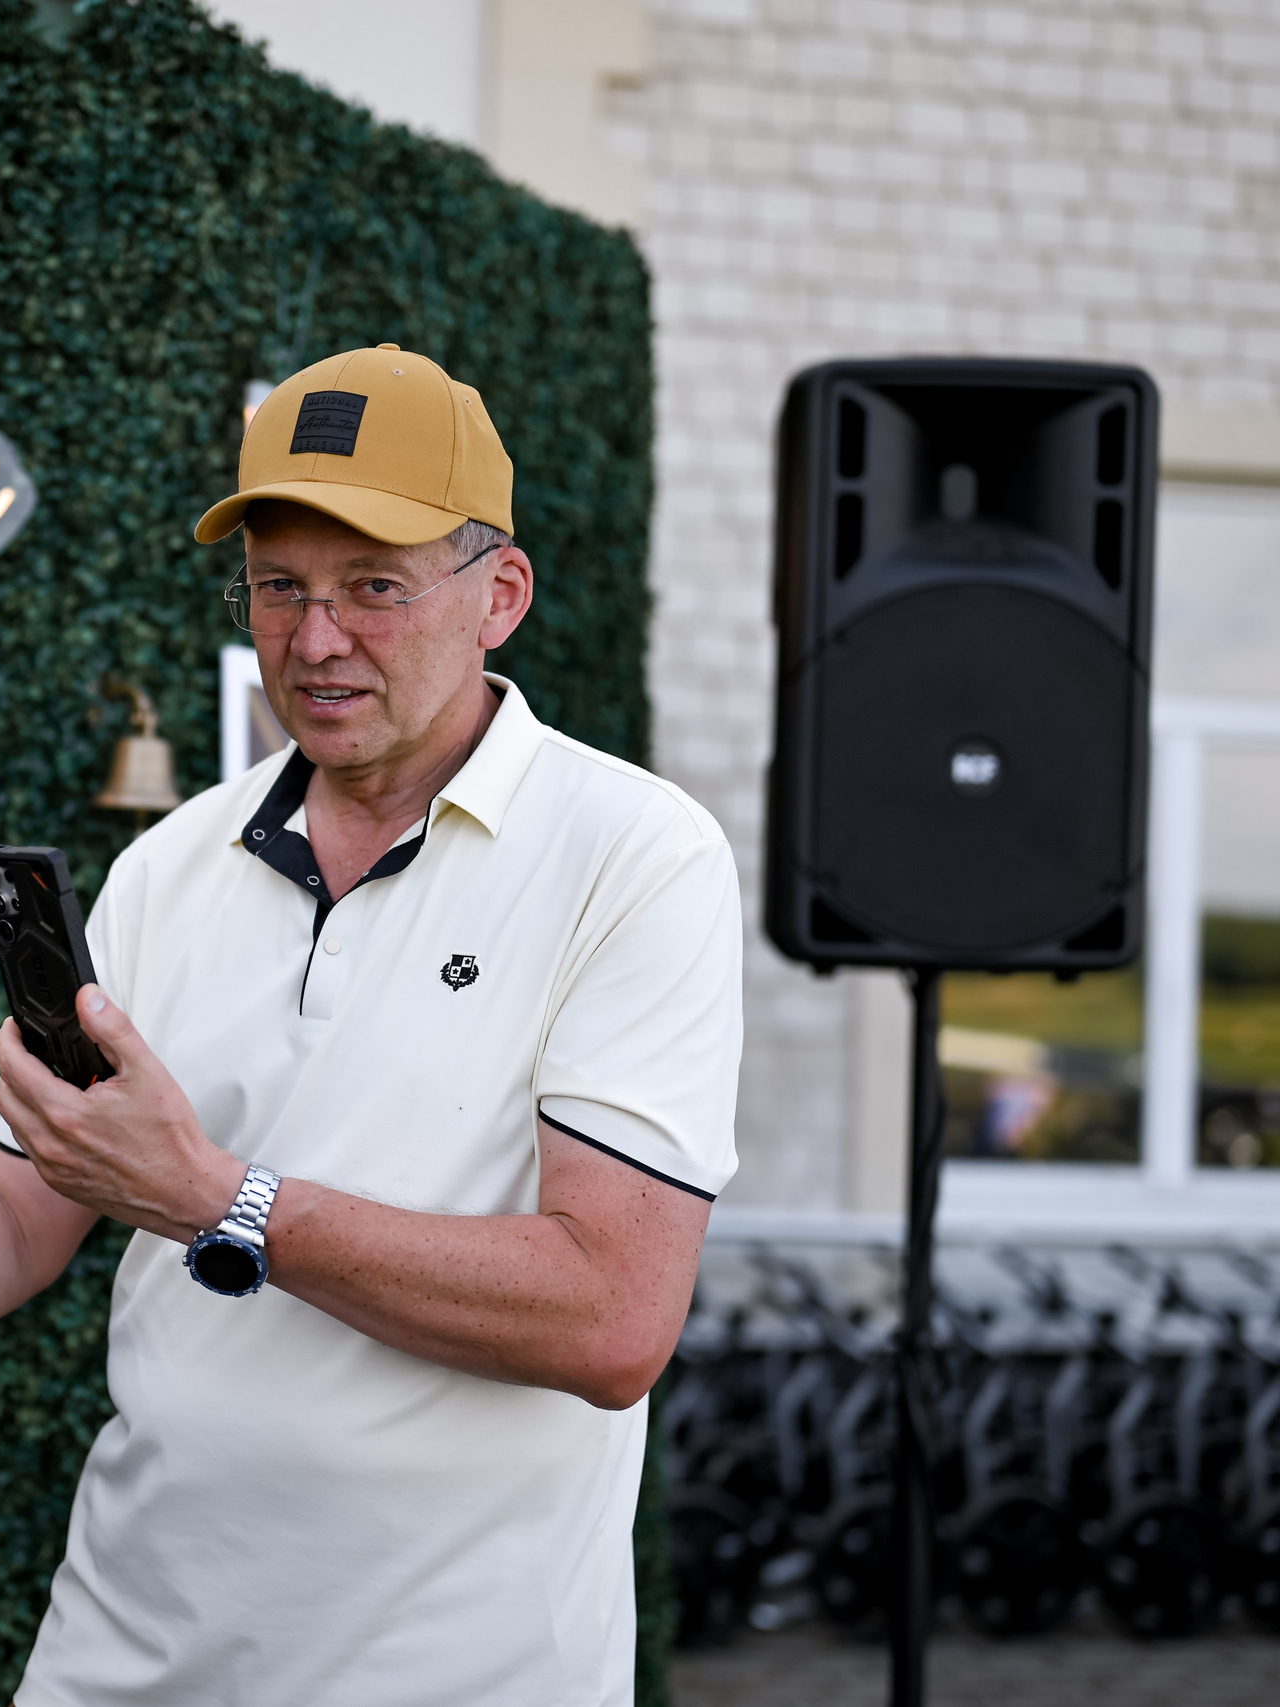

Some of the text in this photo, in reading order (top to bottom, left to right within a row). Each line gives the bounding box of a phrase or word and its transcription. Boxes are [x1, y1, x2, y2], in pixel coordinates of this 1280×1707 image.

[306, 395, 358, 408] NATIONAL
[297, 414, 358, 433] Authentic
[297, 440, 346, 452] LEAGUE
